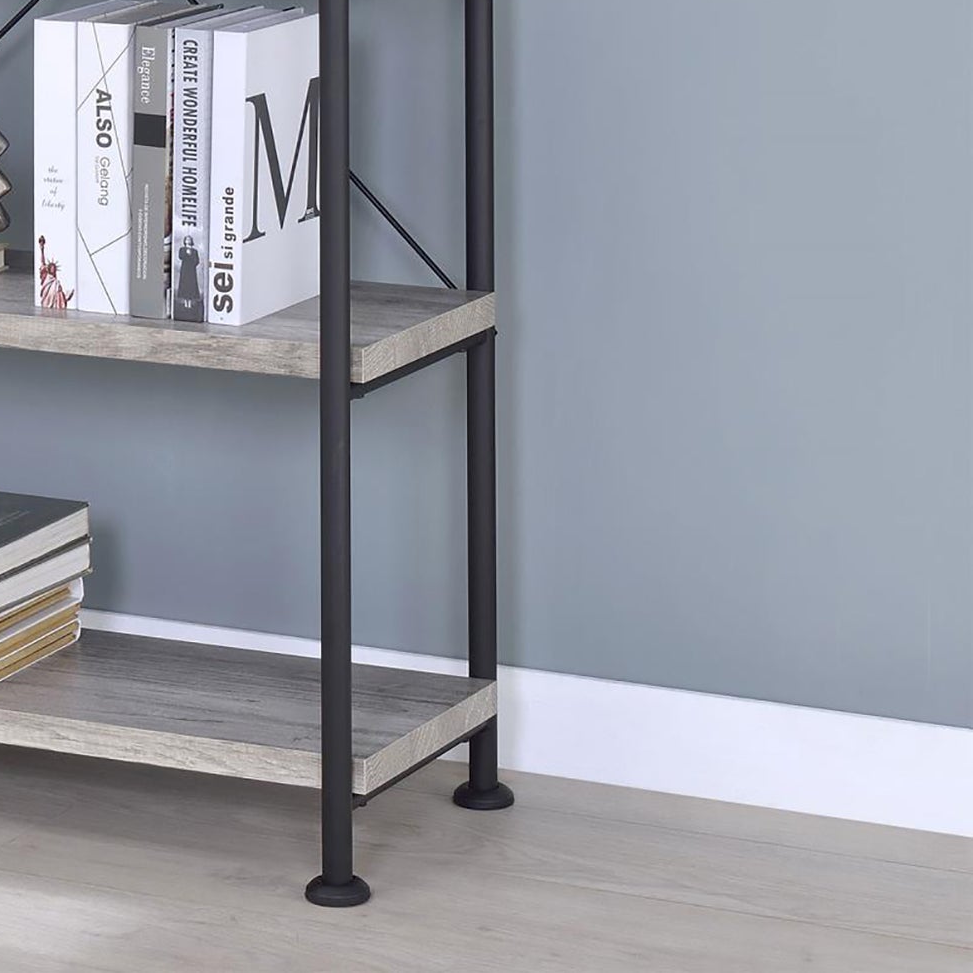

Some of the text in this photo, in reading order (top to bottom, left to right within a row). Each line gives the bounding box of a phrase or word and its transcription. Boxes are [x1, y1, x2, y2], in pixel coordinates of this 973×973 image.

[138, 46, 156, 104] Elegance
[181, 39, 199, 228] CREATE WONDERFUL HOMELIFE
[95, 87, 113, 206] ALSO Gelang
[243, 76, 320, 244] M
[209, 186, 236, 314] sei si grande
